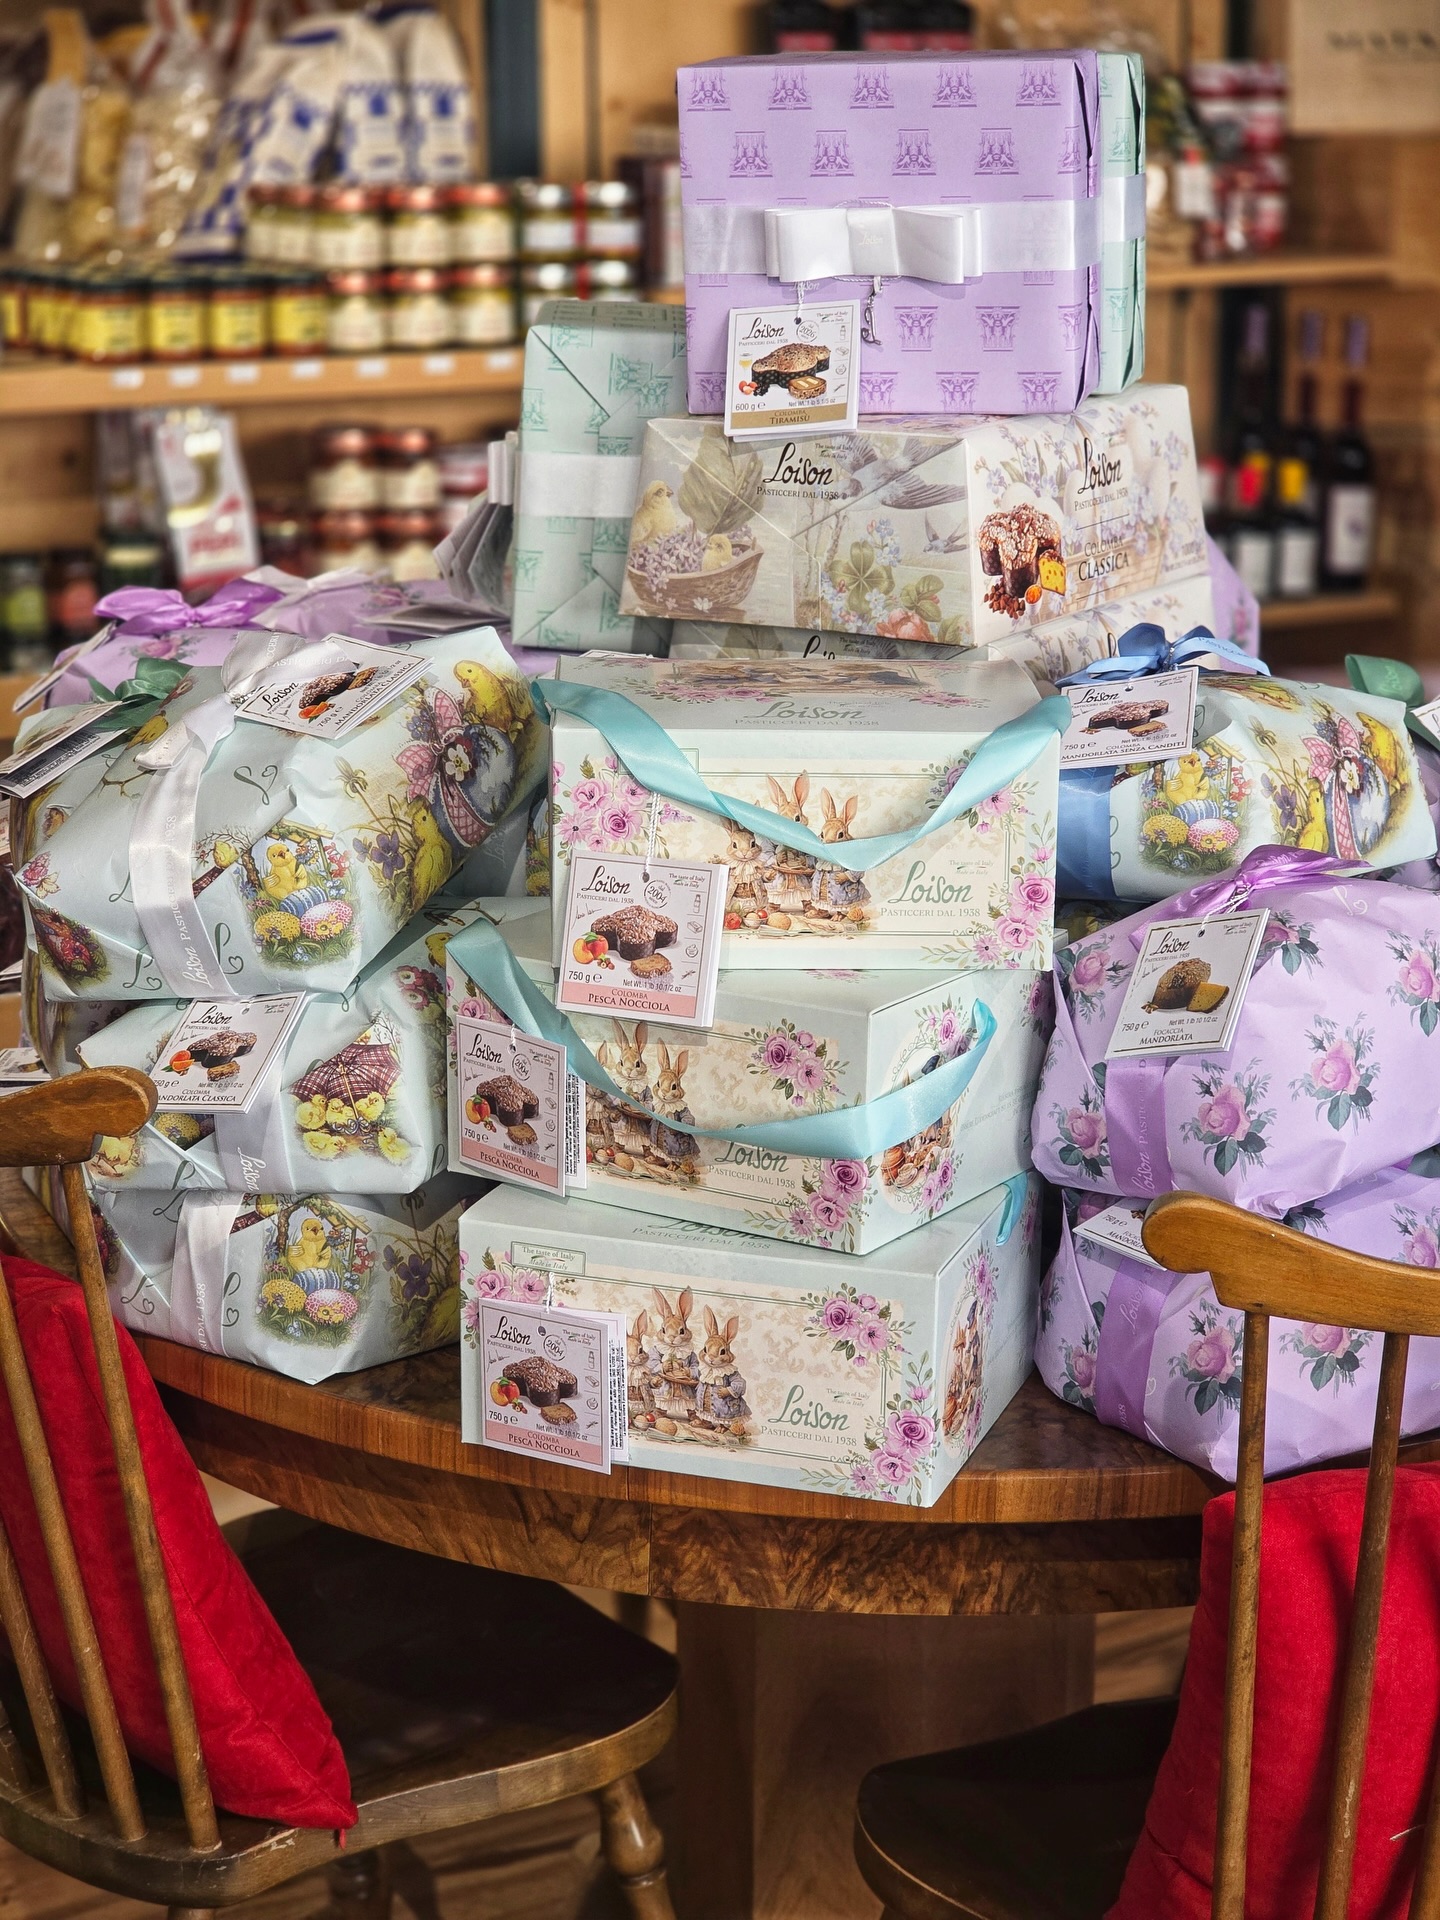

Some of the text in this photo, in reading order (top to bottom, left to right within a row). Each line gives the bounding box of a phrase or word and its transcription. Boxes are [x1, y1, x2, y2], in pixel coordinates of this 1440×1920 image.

[742, 317, 785, 340] Loison
[800, 326, 815, 338] 2026
[763, 442, 834, 486] Loison
[1078, 437, 1123, 494] Loison
[756, 487, 839, 500] PASTICCERI DAL 1938
[1084, 535, 1123, 557] COLOMBA
[1078, 552, 1129, 582] CLASSICA
[262, 681, 299, 711] Loison
[334, 687, 381, 726] MANDORLATA
[380, 662, 415, 691] CLASSICA
[1074, 688, 1120, 705] Loison
[743, 701, 867, 719] Loison
[317, 716, 330, 727] 750
[1061, 750, 1119, 760] MANDORLATA
[164, 814, 178, 843] 1938
[581, 865, 631, 895] Loison
[887, 860, 973, 903] Loison
[576, 893, 607, 902] PASTICCERI
[647, 886, 667, 904] 2004
[880, 908, 934, 917] PASTICCERI
[959, 909, 980, 917] 1938
[1149, 931, 1190, 956] Loison
[181, 945, 214, 989] Loison
[568, 971, 590, 983] 750 g
[588, 994, 670, 1011] PESCA NOCCIOLA
[611, 989, 648, 999] COLOMBA
[191, 1005, 233, 1024] Loison
[1122, 1023, 1135, 1032] 750
[466, 1033, 503, 1064] Loison
[1139, 1033, 1193, 1045] MANDORLATA
[515, 1058, 529, 1076] 2004
[464, 1128, 481, 1142] 750 g
[480, 1152, 540, 1179] PESCA NOCCIOLA
[495, 1150, 523, 1164] COLOMBA
[237, 1147, 266, 1192] Loison
[708, 1165, 796, 1189] PASTICCERI DAL 1938
[1131, 1152, 1155, 1195] Loison
[632, 1227, 771, 1249] PASTICCERI DAL 1938
[522, 1246, 534, 1254] The
[560, 1252, 575, 1261] Italy
[553, 1262, 568, 1270] Italy
[195, 1282, 206, 1312] 1938
[490, 1316, 532, 1345] Loison
[546, 1339, 565, 1357] 2004
[489, 1411, 509, 1424] 750 g
[768, 1385, 850, 1431] Loison
[508, 1433, 580, 1457] PESCA NOCCIOLA
[527, 1431, 560, 1444] COLOMBA
[761, 1426, 857, 1446] PASTICCERI DAL 1938
